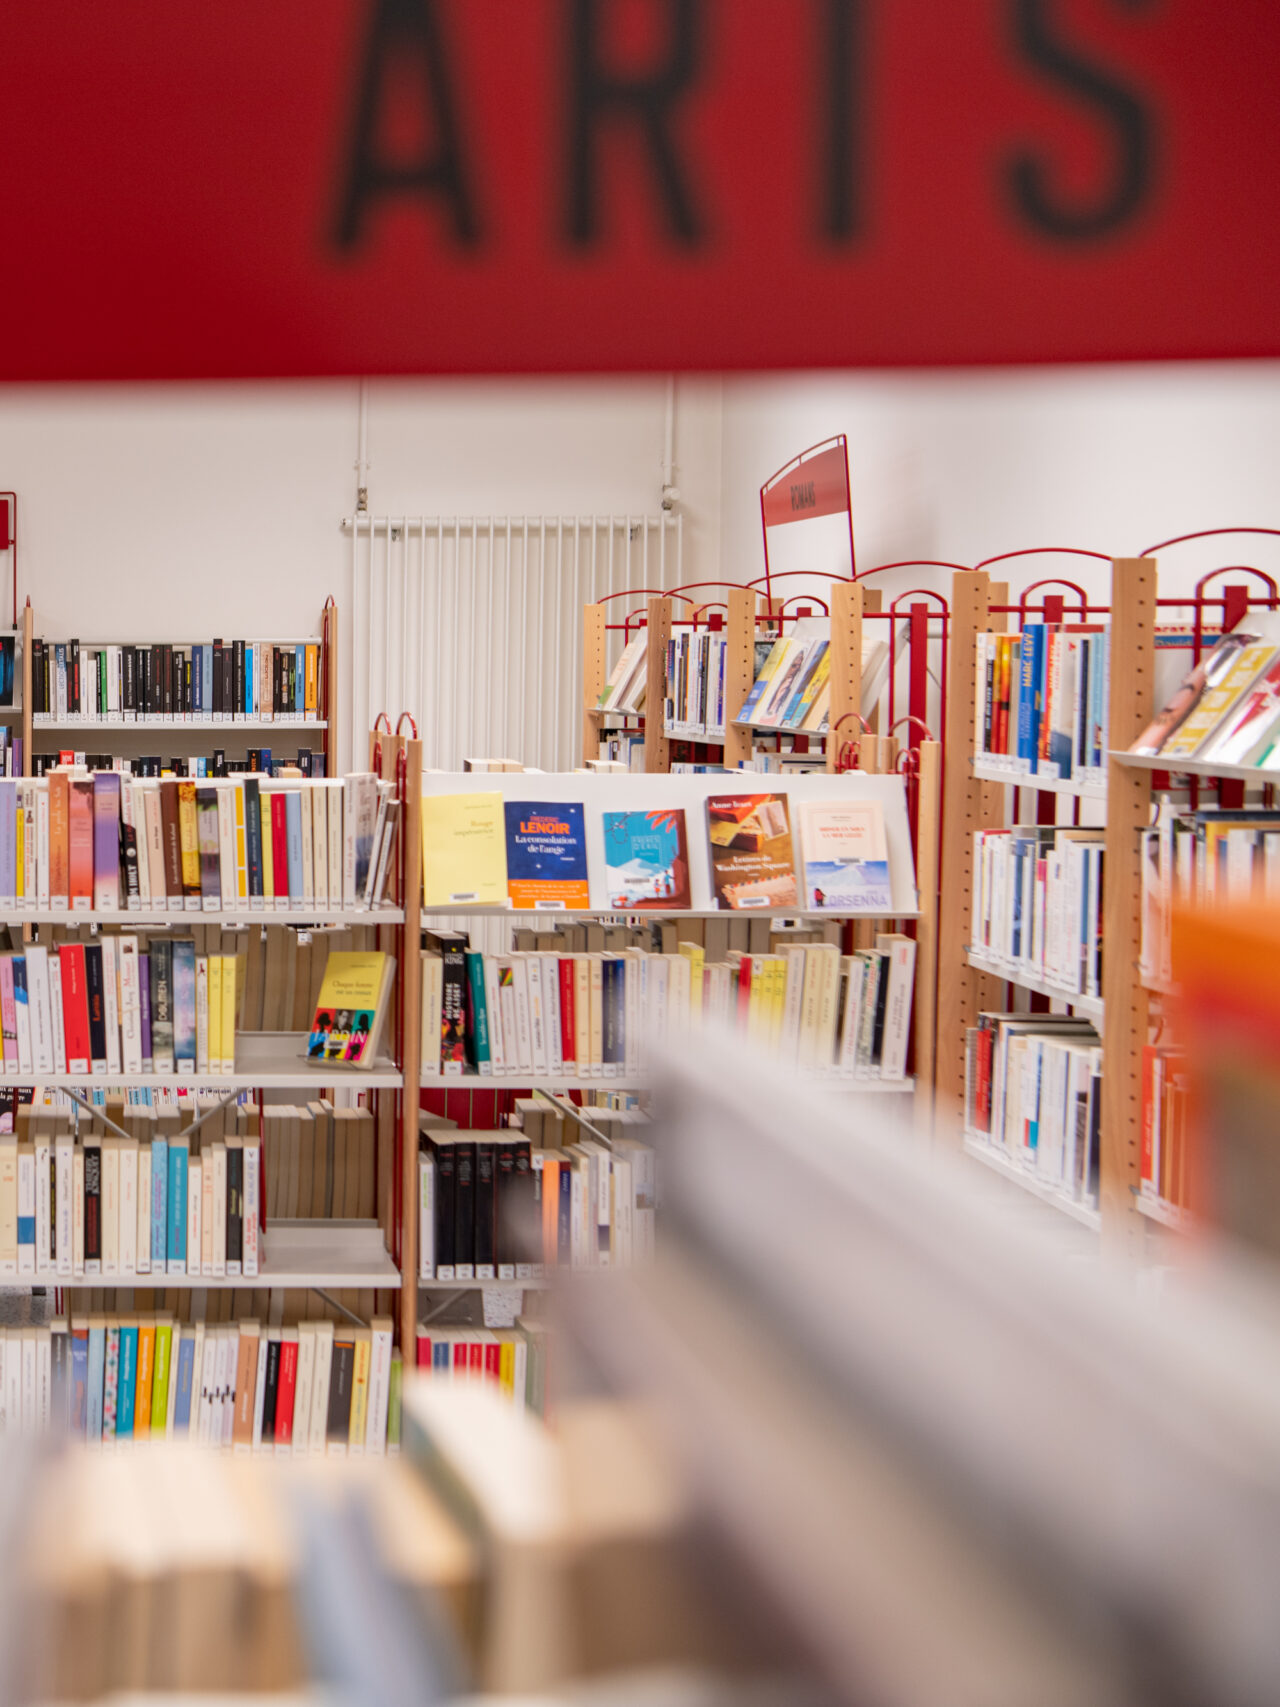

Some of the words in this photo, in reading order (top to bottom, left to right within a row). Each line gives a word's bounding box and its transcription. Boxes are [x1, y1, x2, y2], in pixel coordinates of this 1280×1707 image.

[1022, 632, 1034, 657] LEVY
[1021, 660, 1033, 687] MARC
[520, 822, 570, 834] LENOIR
[515, 836, 525, 844] La
[526, 835, 577, 844] consolation
[527, 845, 538, 853] de
[539, 845, 565, 855] l'ange
[733, 856, 760, 864] Lettres
[157, 980, 168, 1021] DOLMEN
[445, 983, 453, 1019] HISTOIRE
[314, 1028, 367, 1042] JARDIN
